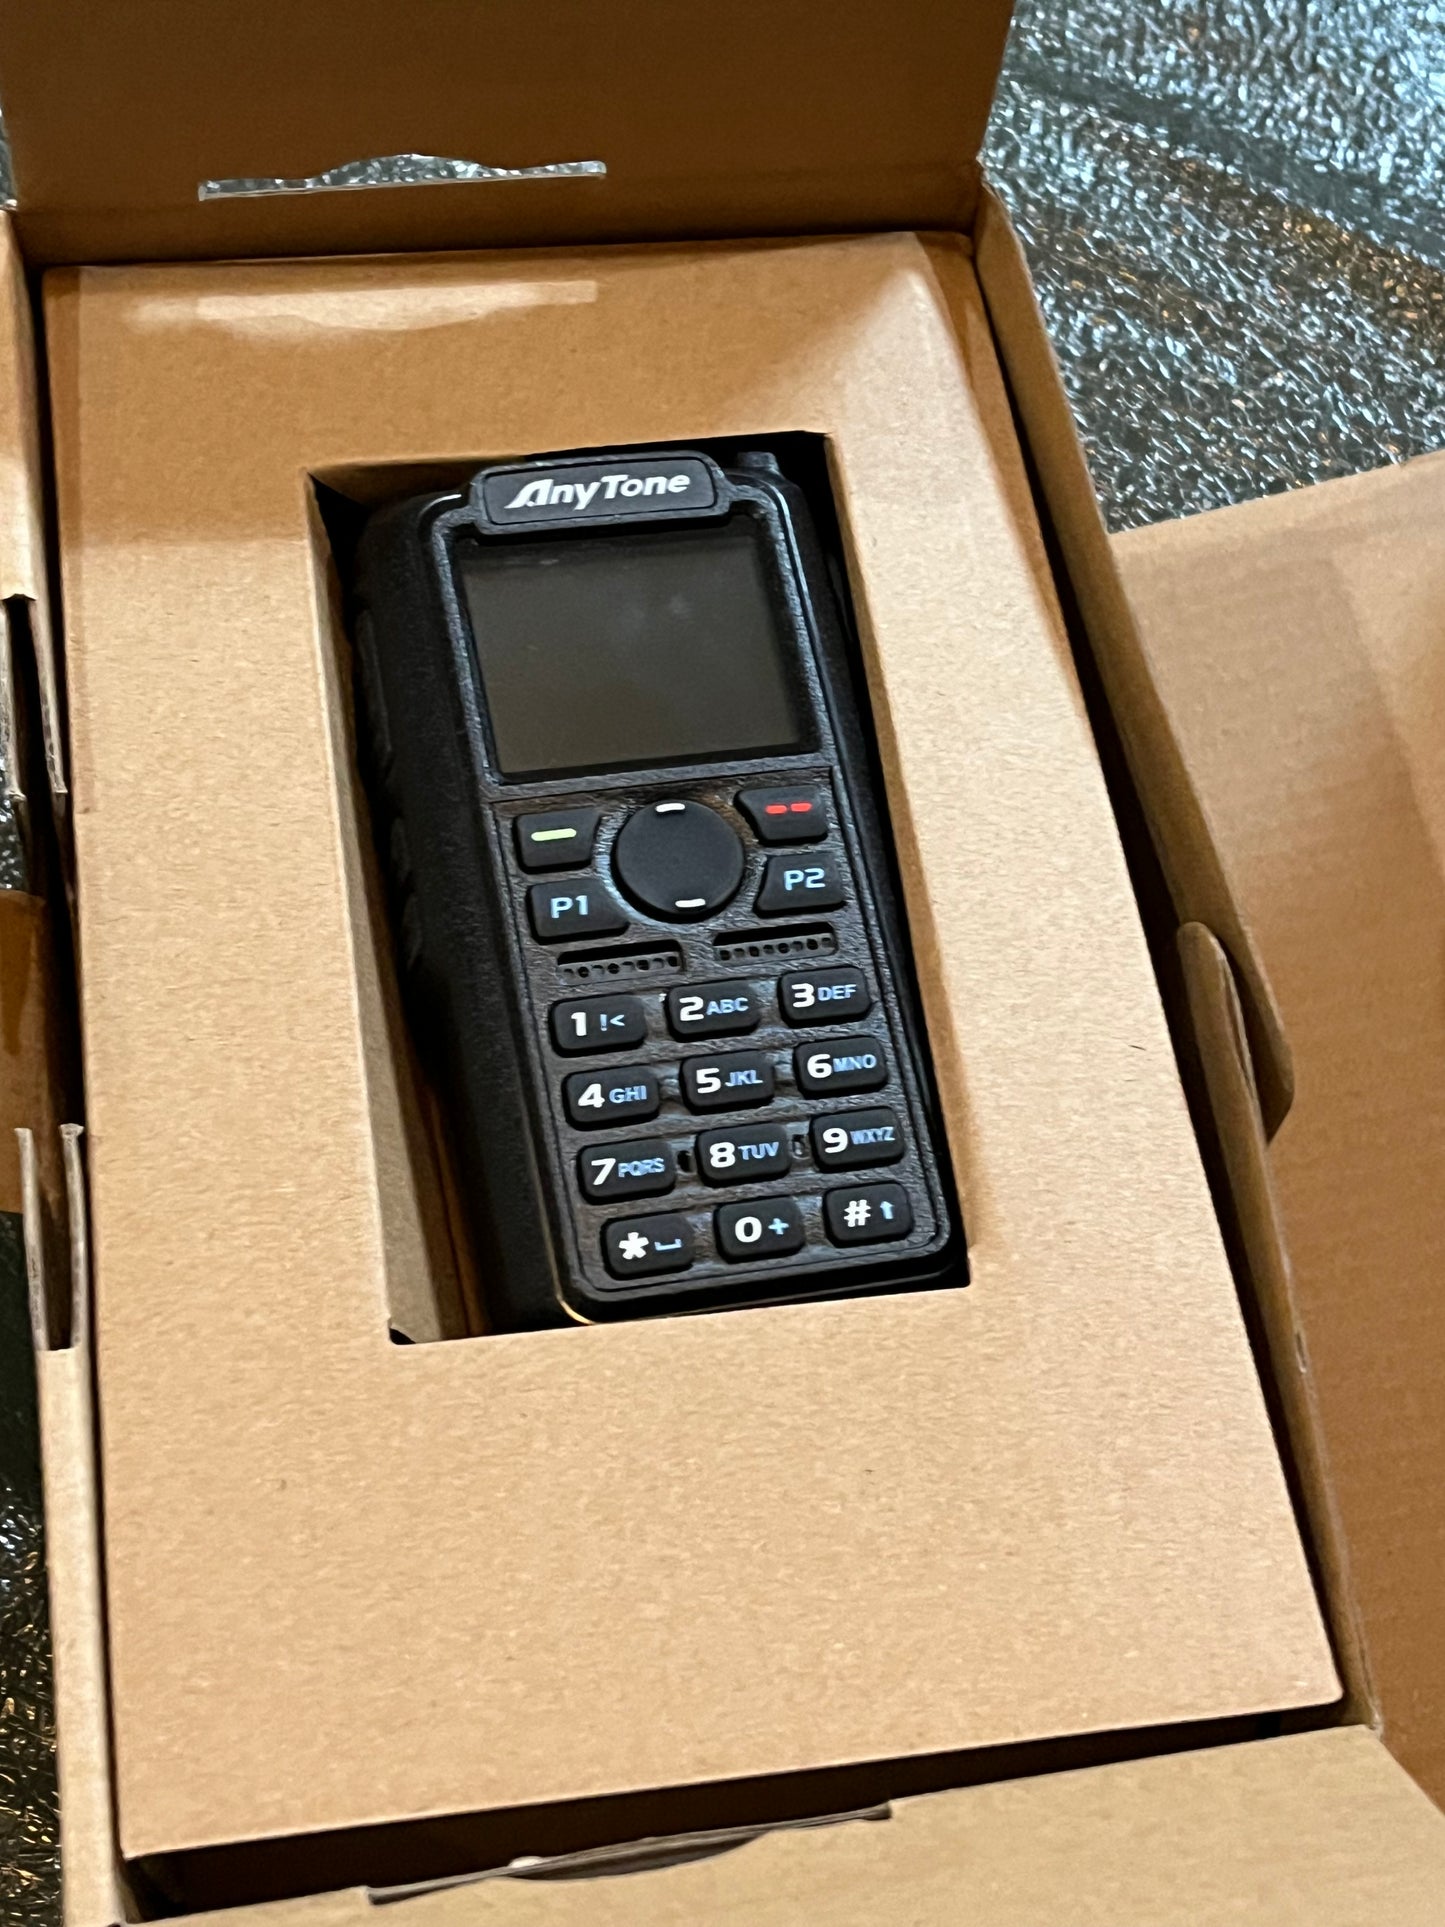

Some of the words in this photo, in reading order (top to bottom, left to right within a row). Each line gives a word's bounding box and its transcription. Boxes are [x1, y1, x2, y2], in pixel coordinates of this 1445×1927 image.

[504, 474, 690, 511] AnyTone
[784, 868, 825, 890] P2
[551, 895, 588, 918] P1
[792, 983, 814, 1007] 3
[818, 984, 856, 1001] DEF
[680, 996, 704, 1021] 2
[706, 997, 748, 1015] ABC
[571, 1012, 586, 1036] 1
[807, 1054, 832, 1078] 6
[697, 1068, 721, 1093] 5
[725, 1070, 763, 1086] JKL
[578, 1084, 605, 1107] 4
[609, 1086, 646, 1103] GHI
[823, 1128, 848, 1153] 9
[710, 1142, 735, 1167] 8
[738, 1142, 779, 1160] TUV
[591, 1158, 616, 1185] 7
[735, 1217, 762, 1242] 0
